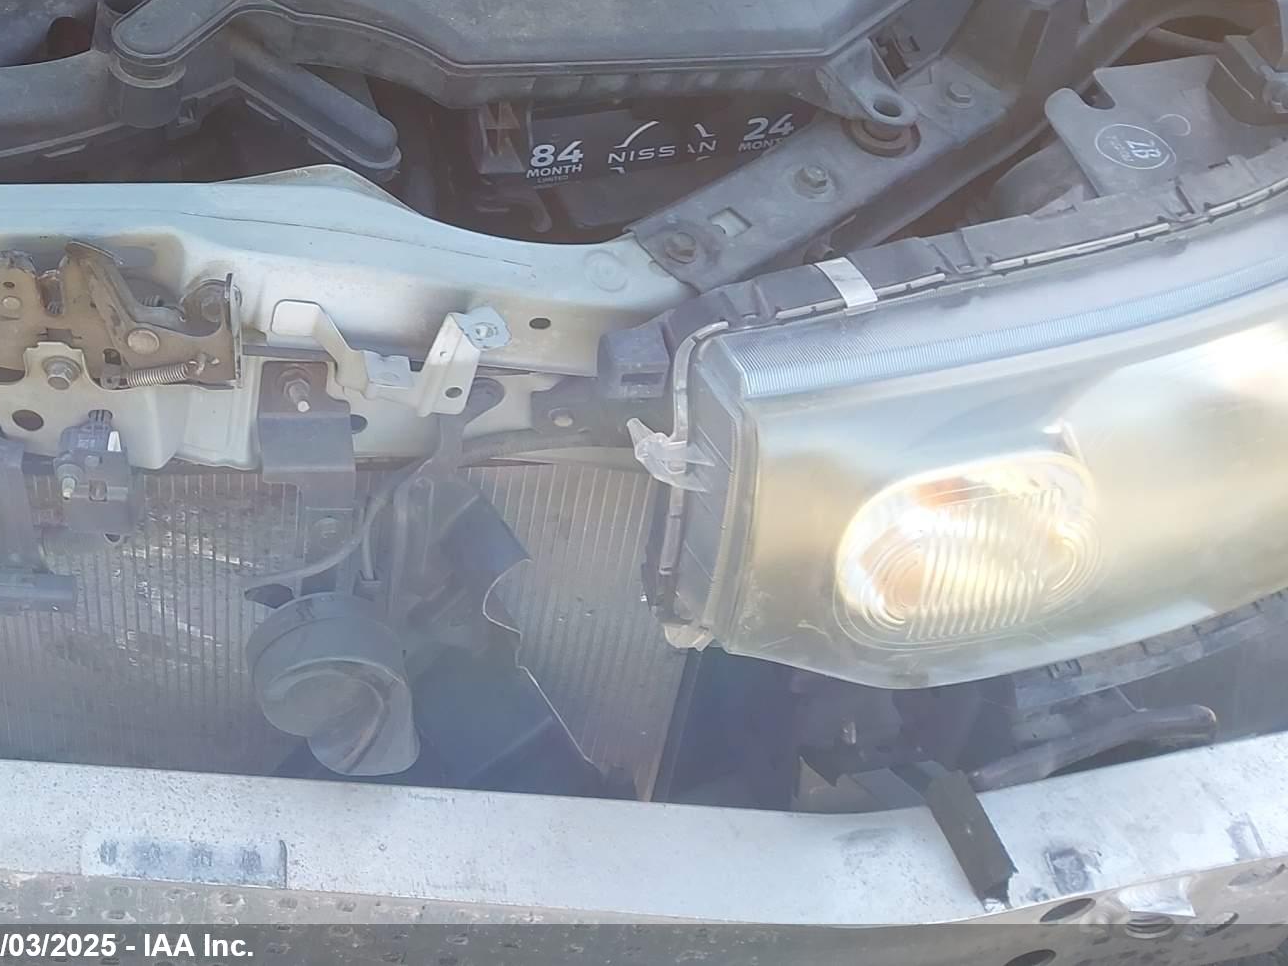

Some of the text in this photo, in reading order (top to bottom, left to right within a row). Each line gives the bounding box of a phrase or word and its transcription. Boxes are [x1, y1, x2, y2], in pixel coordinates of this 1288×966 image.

[743, 113, 795, 141] 24
[530, 140, 583, 167] 84
[526, 163, 583, 179] MONTH
